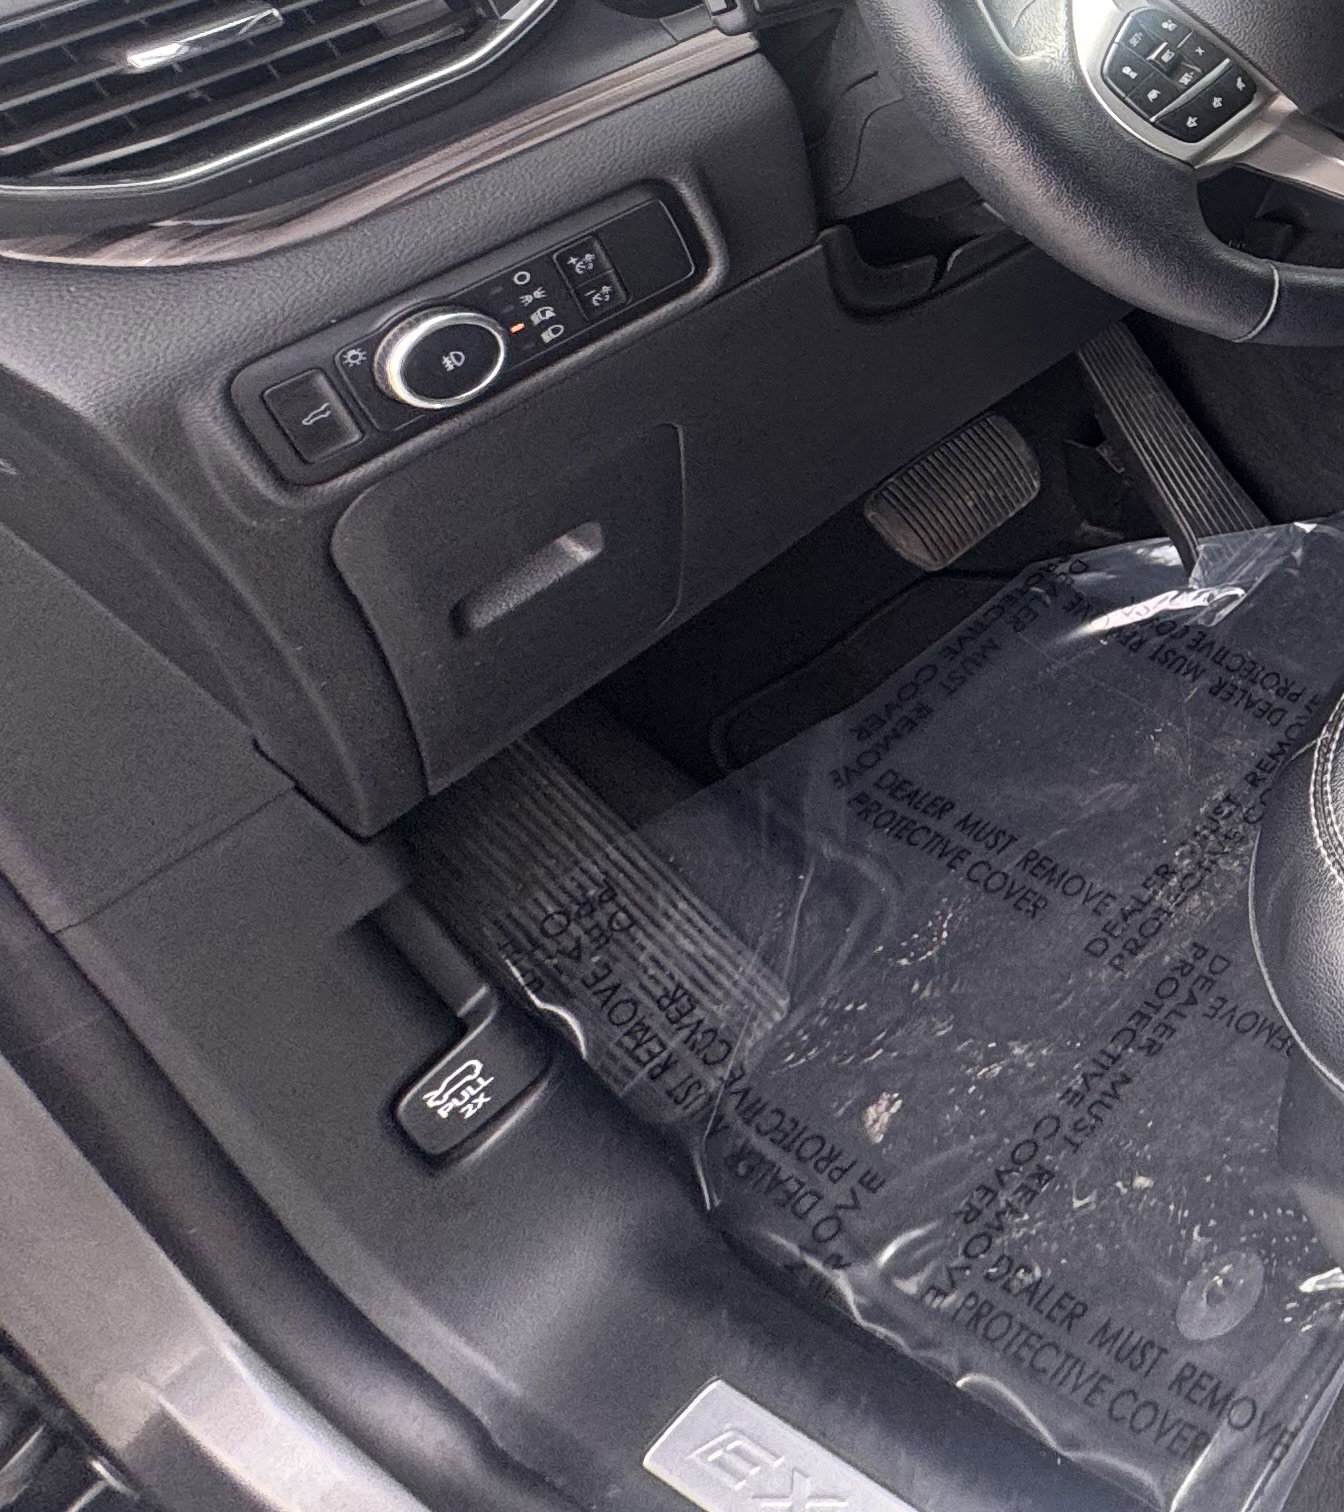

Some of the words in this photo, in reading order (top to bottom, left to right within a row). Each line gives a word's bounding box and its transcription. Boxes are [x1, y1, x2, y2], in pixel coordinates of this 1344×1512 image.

[849, 659, 938, 743] COVER
[938, 637, 1001, 696] MUST
[1148, 644, 1206, 683] MUST
[1186, 629, 1306, 704] PROTECTIVE
[1207, 676, 1287, 727] DEALER
[828, 700, 933, 791] REMOVE
[845, 788, 970, 872] PROTECTIVE
[964, 856, 1049, 920] COVER
[872, 765, 955, 823] DEALER
[952, 810, 1018, 858] MUST
[1014, 847, 1116, 916] REMOVE
[1085, 860, 1177, 960] DEALER
[582, 961, 677, 1082] REMOVE
[654, 981, 733, 1070] COVER
[1059, 939, 1208, 1110] PROTECTIVE
[1137, 952, 1231, 1060] DEALER
[437, 1076, 495, 1119] PULL
[460, 1092, 491, 1119] 2X
[712, 1062, 857, 1184] PROTECTIVE
[1059, 1070, 1133, 1152] MUST
[954, 1111, 1063, 1227] COVER
[920, 1161, 1056, 1312] REMOVE
[949, 1289, 1115, 1409] PROTECTIVE
[1102, 1383, 1212, 1466] COVER
[982, 1251, 1090, 1333] DEALER
[1087, 1315, 1168, 1380] MUST
[1167, 1359, 1299, 1462] REMOVE
